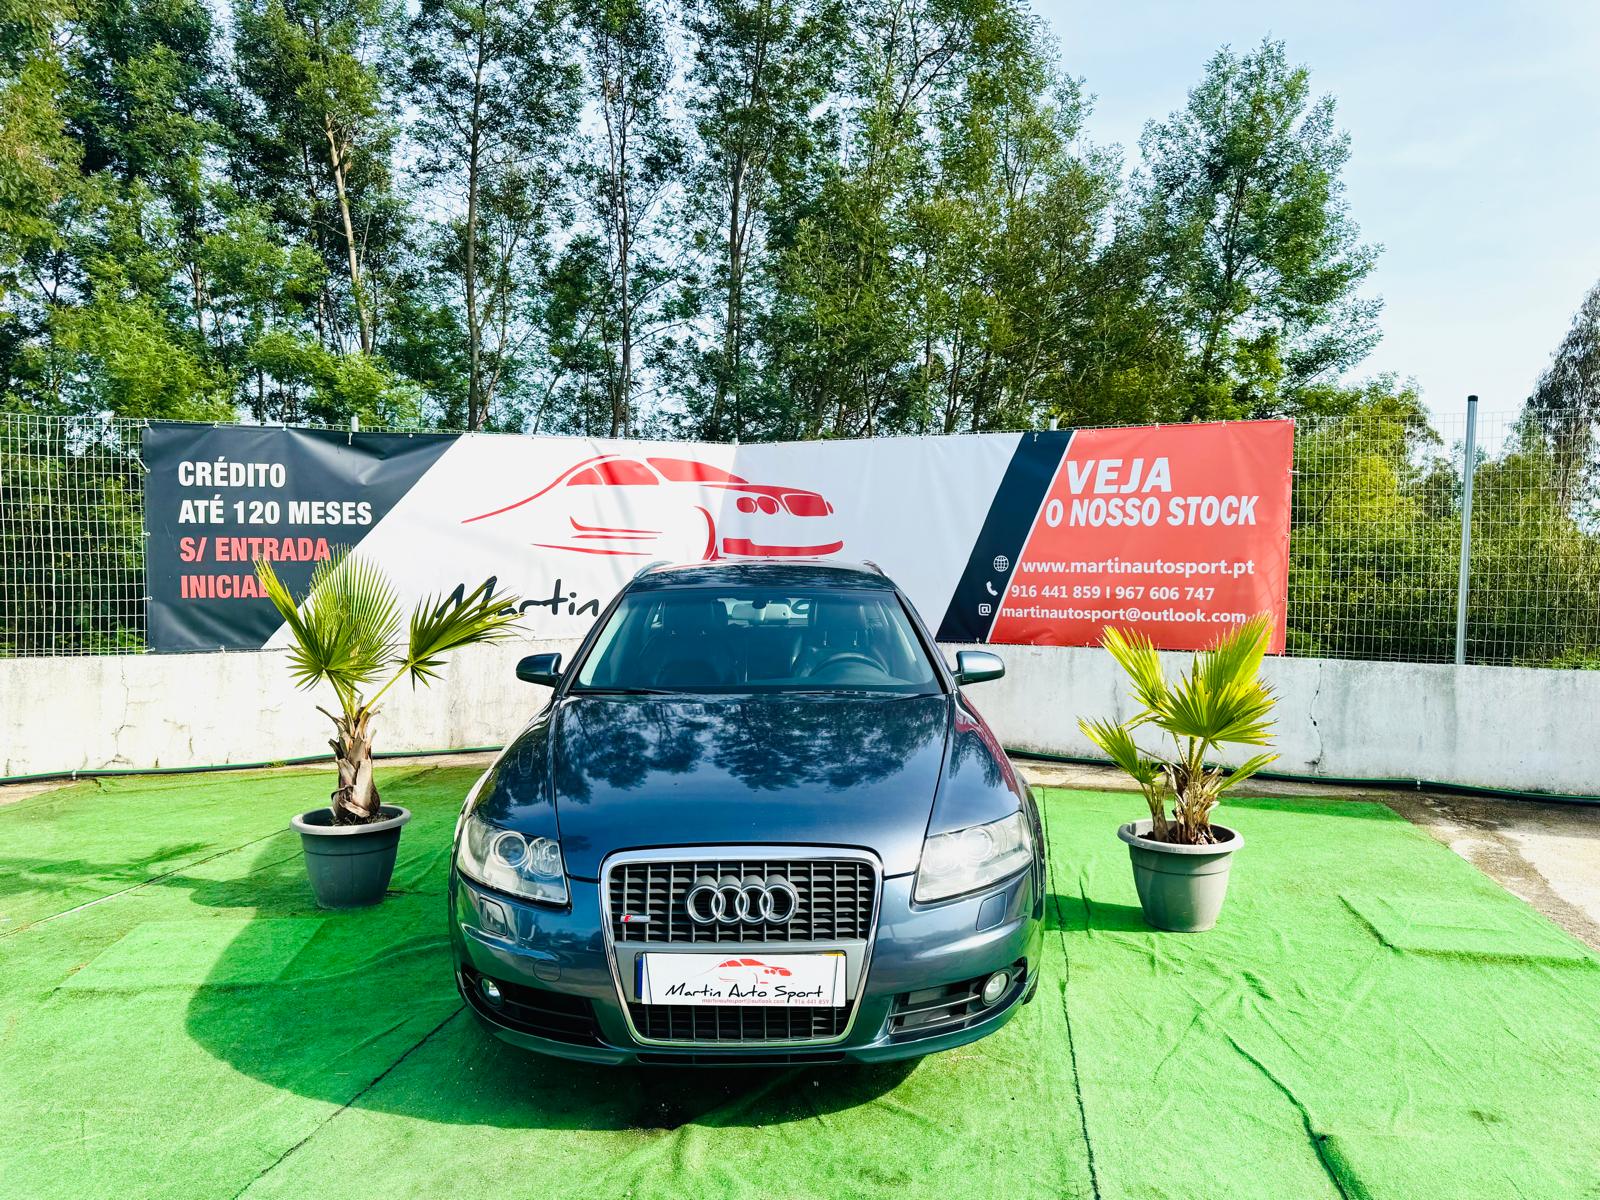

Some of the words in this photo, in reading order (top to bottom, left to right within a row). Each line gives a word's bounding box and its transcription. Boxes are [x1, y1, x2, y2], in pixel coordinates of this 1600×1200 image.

[178, 456, 287, 488] CRÉDITO
[1066, 457, 1172, 495] VEJA
[178, 494, 224, 524] ATÉ
[233, 500, 280, 525] 120
[288, 501, 373, 526] MESES
[1046, 498, 1064, 528] O
[1069, 497, 1161, 527] NOSSO
[1167, 495, 1260, 526] STOCK
[180, 537, 207, 563] S/
[215, 537, 331, 562] ENTRADA
[1022, 558, 1255, 579] www.martinautosport.pt
[1011, 585, 1037, 598] 916
[1041, 585, 1068, 598] 441
[1073, 585, 1101, 599] 859
[1115, 586, 1144, 600] 967
[1150, 587, 1180, 600] 606
[1185, 587, 1215, 601] 747
[1002, 605, 1247, 624] martinautosport@outlook.com
[665, 982, 721, 998] Martin
[728, 983, 767, 998] Auto
[774, 985, 823, 1004] Sport
